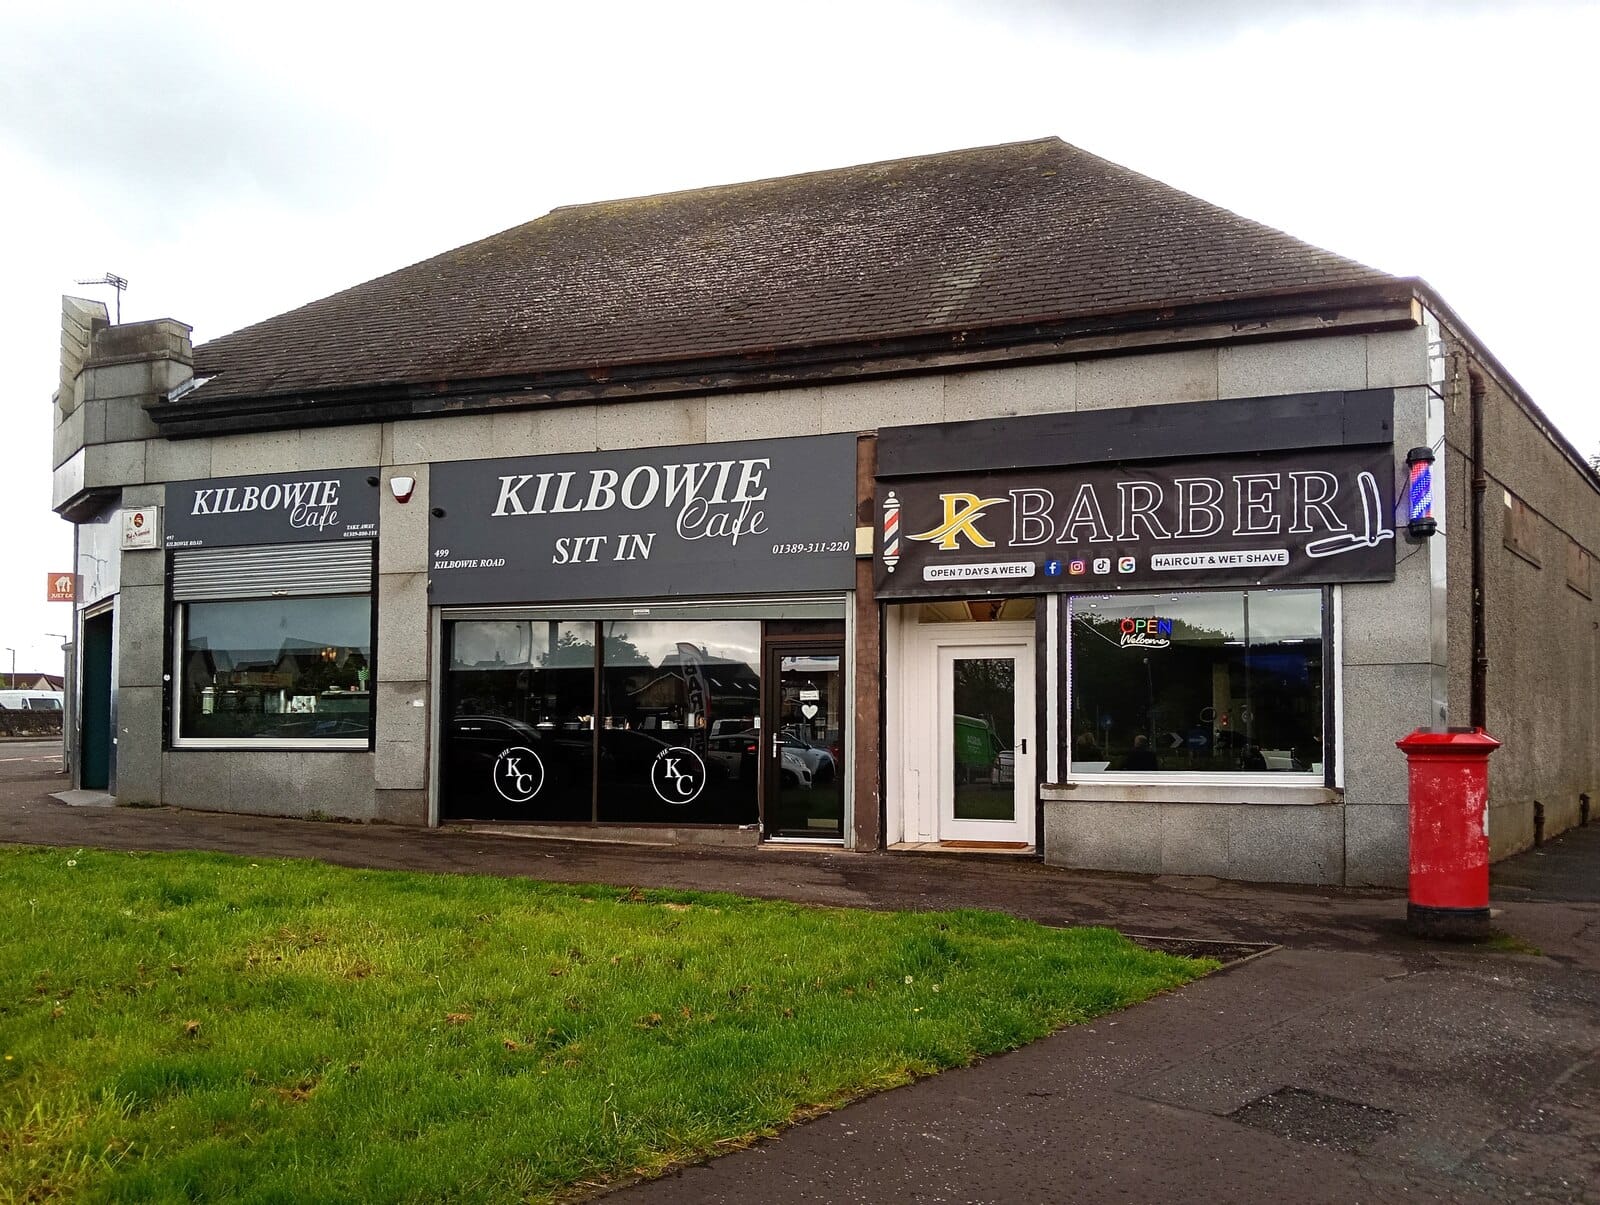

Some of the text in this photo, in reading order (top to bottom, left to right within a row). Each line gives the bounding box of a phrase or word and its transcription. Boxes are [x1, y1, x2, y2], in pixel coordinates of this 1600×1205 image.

[491, 458, 770, 516] KILBOWIE
[190, 480, 341, 515] KILBOWIE
[1008, 470, 1348, 547] BARBER
[289, 502, 340, 532] Cafe
[676, 497, 769, 546] Cafe
[434, 549, 450, 559] 499
[552, 532, 657, 565] SIT IN
[772, 541, 850, 554] 01389-311-220
[434, 558, 506, 570] KILBOWIE ROAD
[1155, 553, 1285, 568] HAIRCUT & WET SHAVE
[930, 566, 1028, 578] OPEN 7 DAYS A WEEK
[1120, 618, 1172, 634] OPEN
[1120, 631, 1170, 649] Welcome
[500, 748, 511, 761] THE
[656, 748, 669, 761] THE
